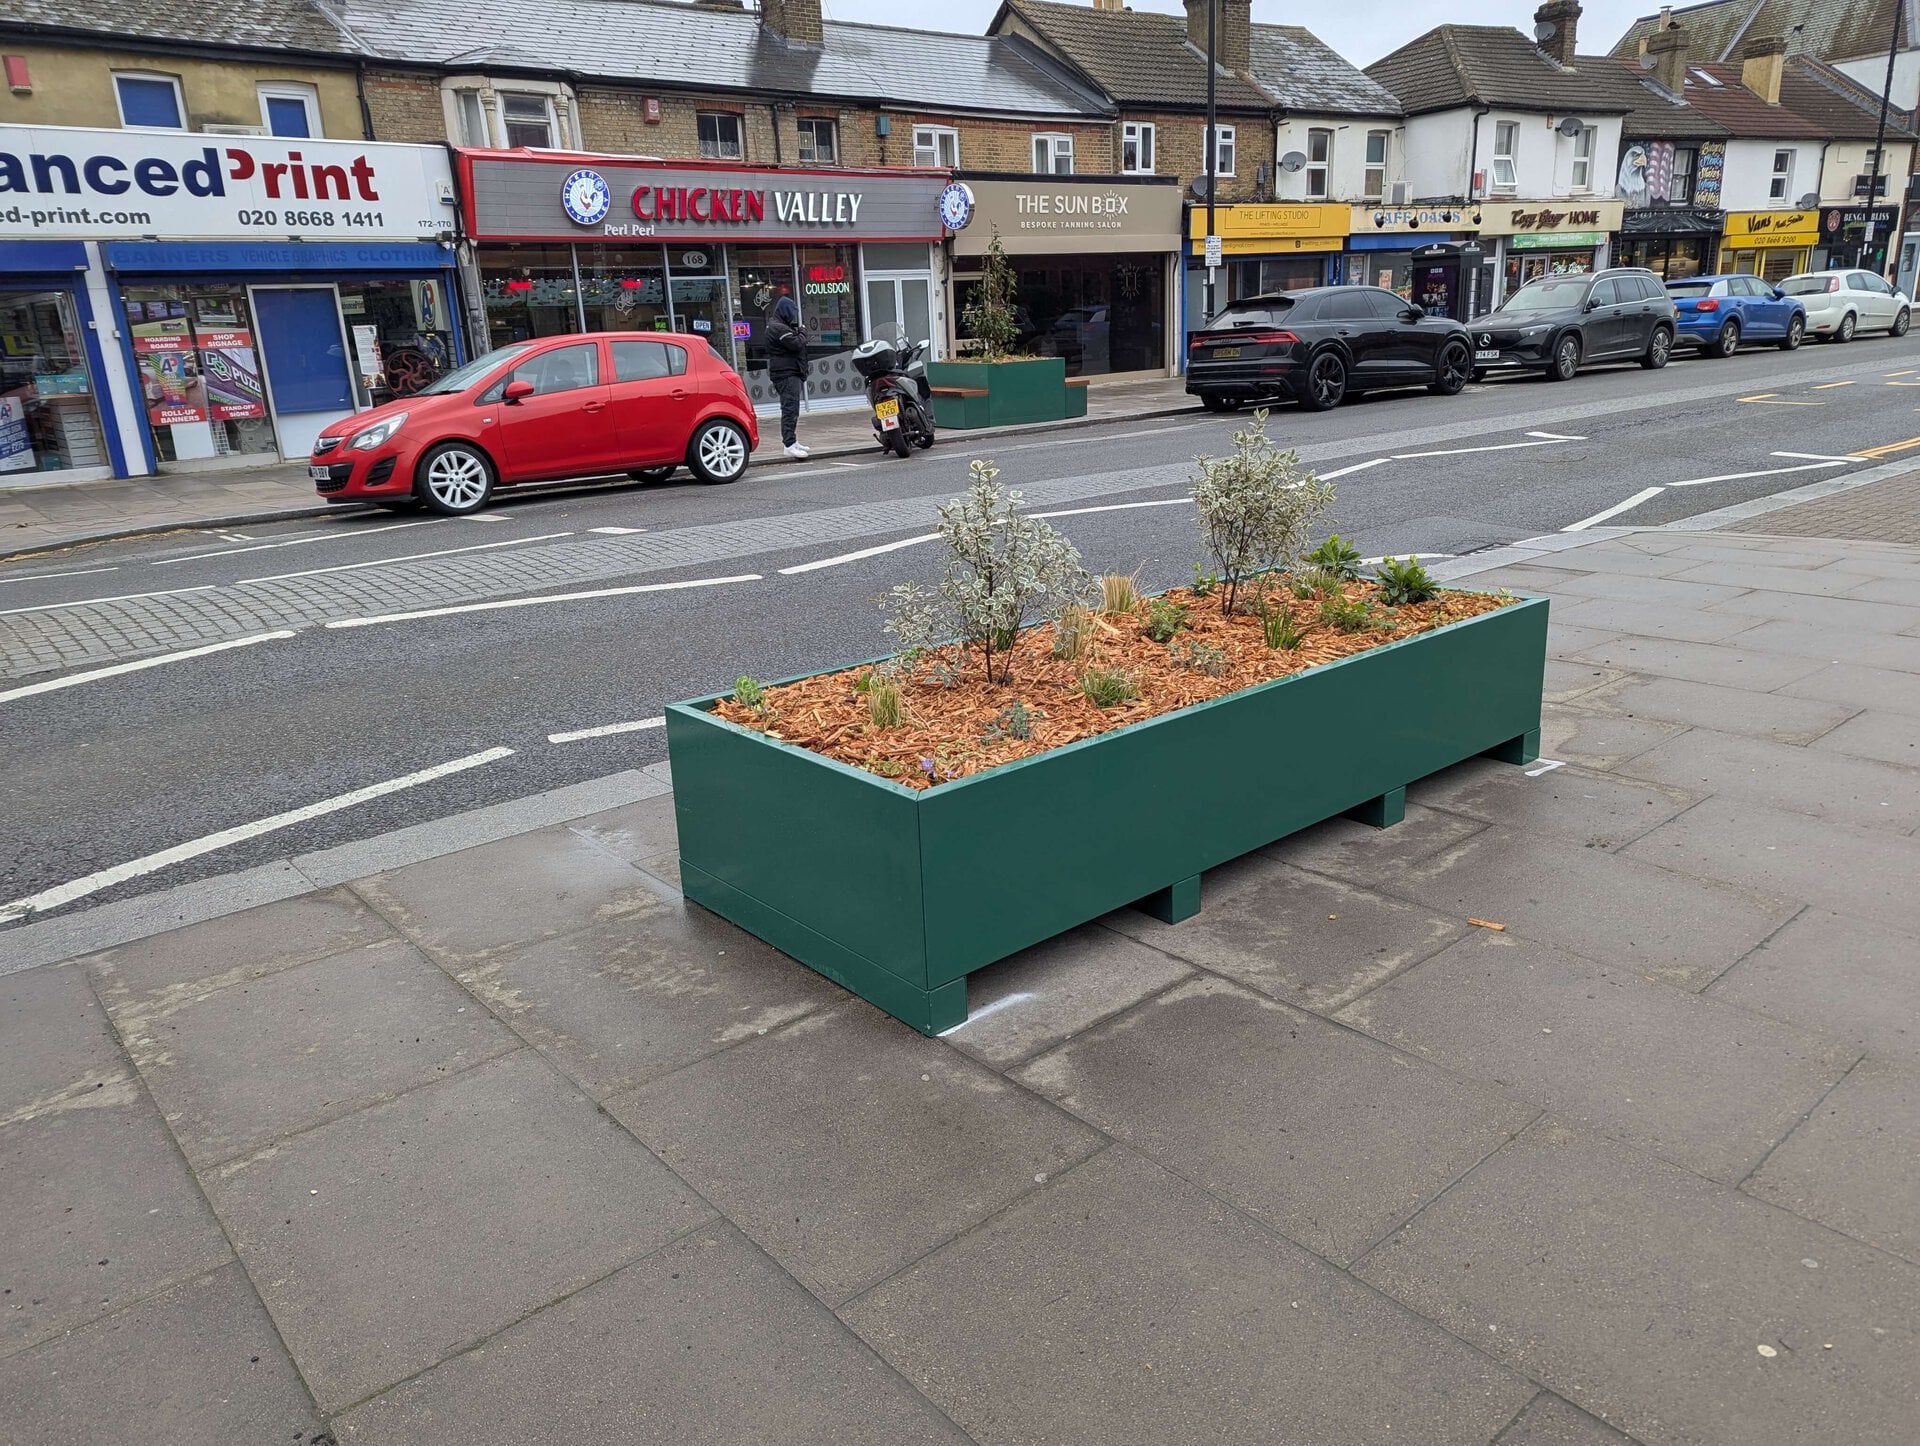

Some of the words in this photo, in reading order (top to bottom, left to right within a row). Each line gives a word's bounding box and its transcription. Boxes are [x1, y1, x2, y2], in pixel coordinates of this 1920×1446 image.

[632, 186, 764, 221] CHICKEN
[775, 192, 863, 223] VALLEY
[1016, 195, 1049, 214] THE
[1054, 195, 1088, 214] SUN
[1092, 192, 1128, 218] BOX
[238, 210, 277, 226] 020
[285, 211, 335, 227] 8668
[342, 212, 383, 227] 1411
[1240, 211, 1252, 219] THE
[1256, 211, 1281, 220] LIFTING
[1284, 210, 1309, 220] STUDIO
[1568, 210, 1600, 225] HOME
[418, 220, 452, 228] 172-170
[1021, 221, 1057, 229] BESPOKE
[1060, 221, 1094, 229] TANNING
[1748, 215, 1772, 233] Vans
[114, 249, 229, 263] BANNERS
[241, 249, 290, 263] VEHICLE
[294, 250, 348, 263] GRAPHICS
[357, 250, 445, 263] CLOTHING
[687, 255, 704, 264] 168
[805, 282, 850, 295] COULSDON
[695, 322, 710, 330] OPEN
[734, 325, 749, 336] PEN
[161, 409, 197, 417] ROLL-UP
[220, 404, 256, 412] STAND-OFF
[160, 415, 200, 424] BANNERS
[885, 419, 895, 427] L
